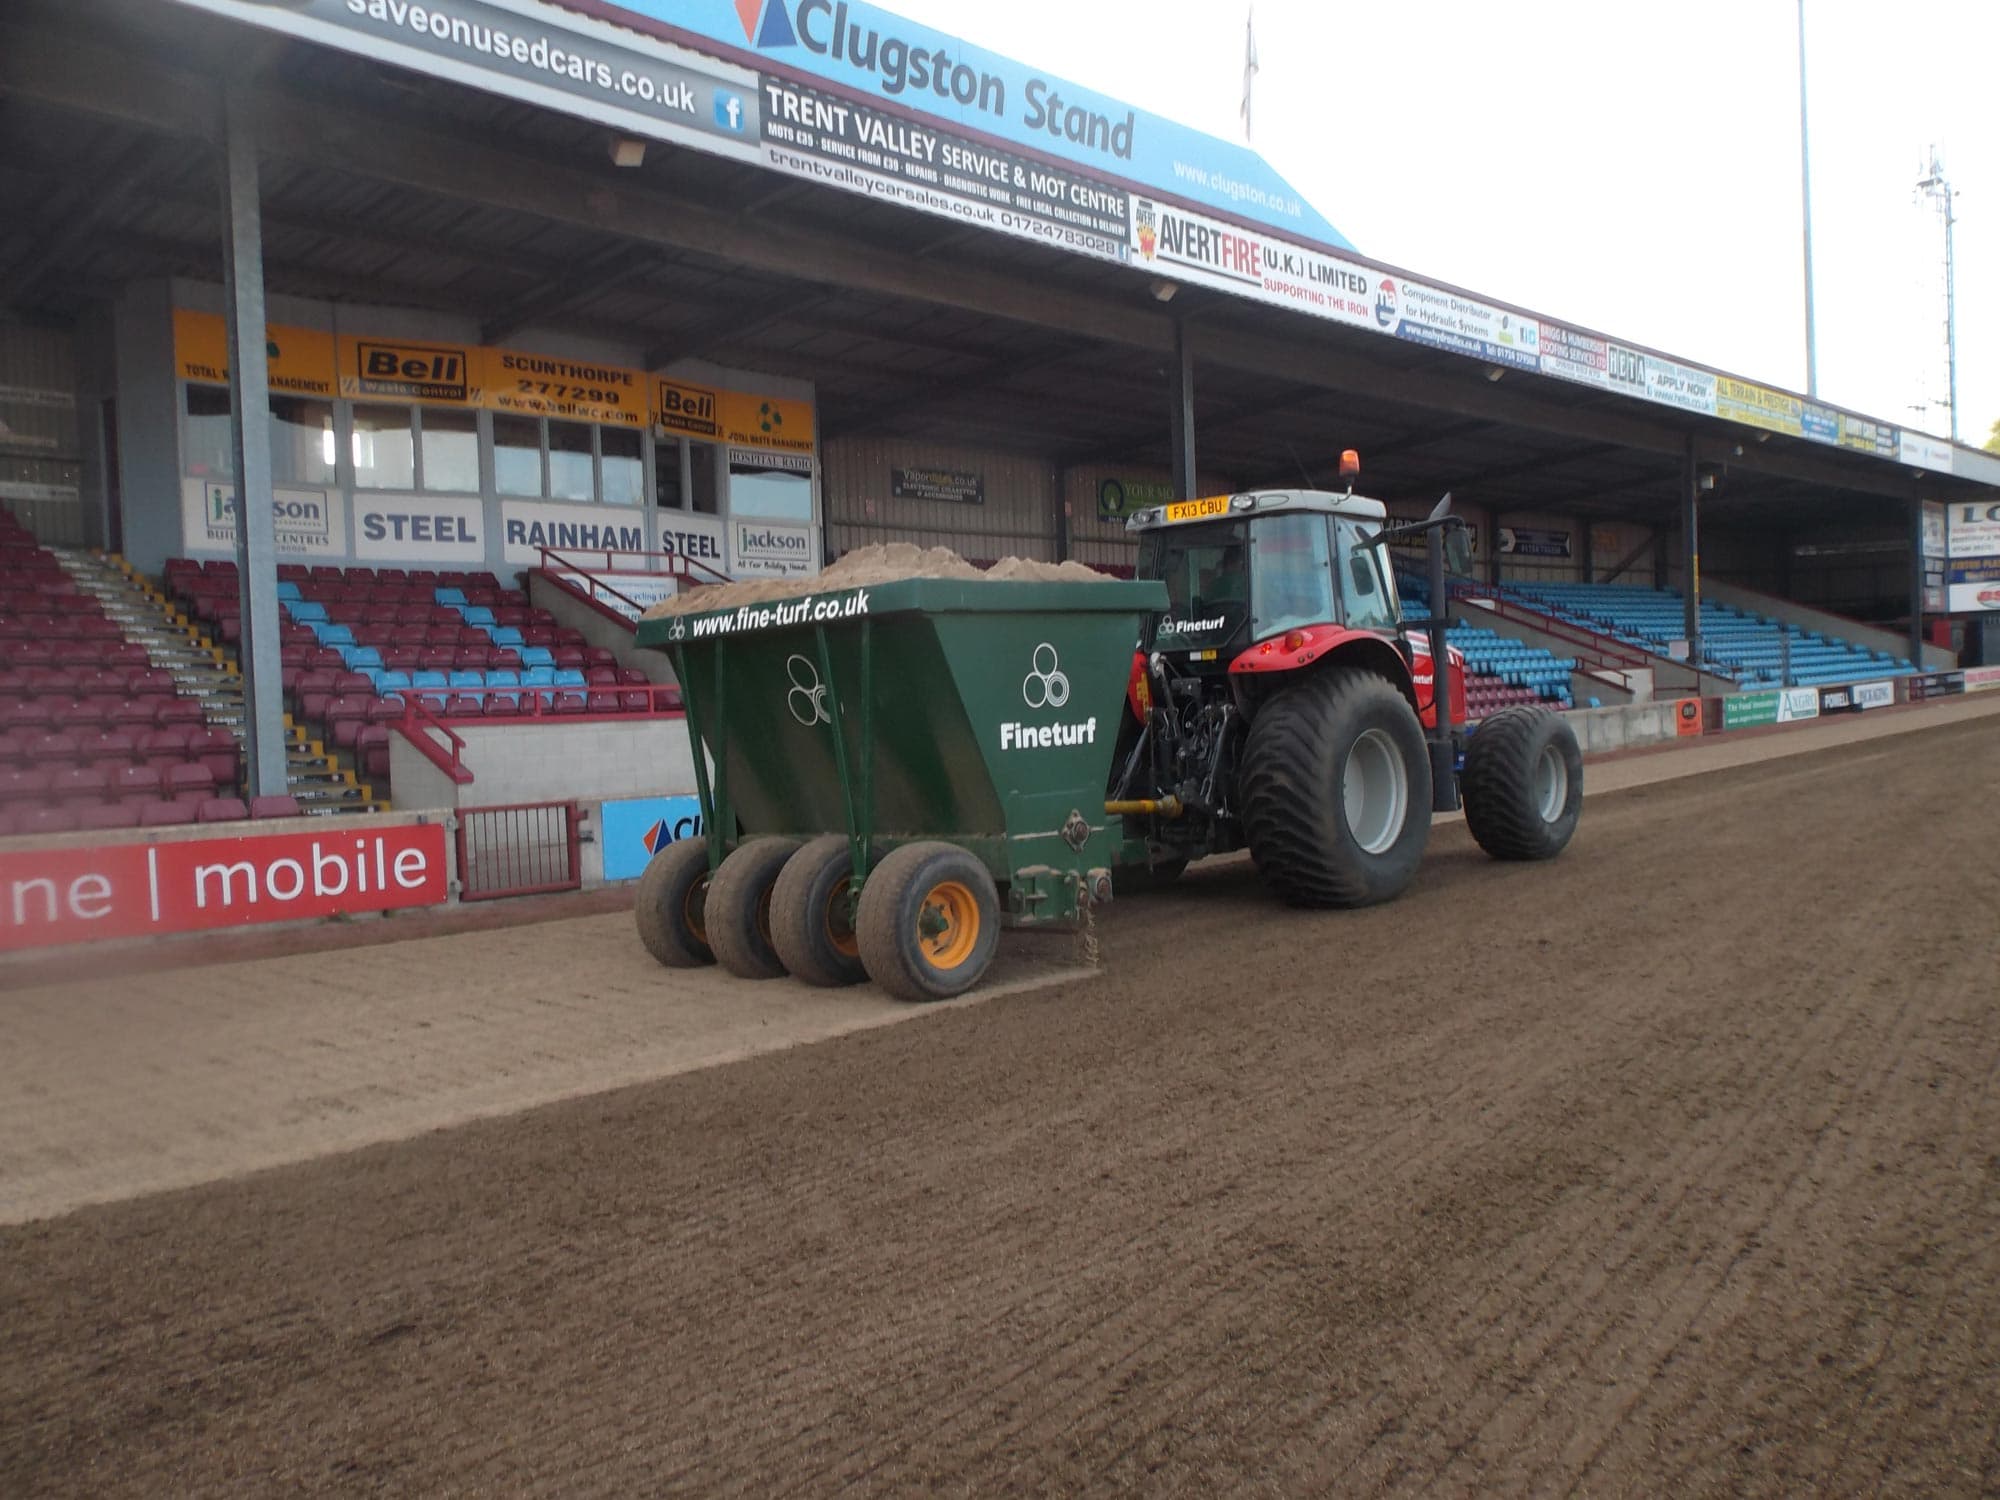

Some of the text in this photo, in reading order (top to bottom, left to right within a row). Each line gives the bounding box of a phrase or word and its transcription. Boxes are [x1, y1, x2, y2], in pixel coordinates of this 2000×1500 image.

[346, 0, 696, 114] saveonusedcars.co.uk
[797, 0, 1134, 160] Clugston Stand
[766, 85, 1125, 218] TRENT VALLEY SERVICE & MOT CENTRE
[768, 122, 794, 141] MOTS
[821, 137, 855, 160] SERVICE
[858, 148, 881, 166] FROM
[906, 162, 937, 183] REPAIRS
[944, 174, 987, 198] DIAGNOSTIC
[989, 187, 1011, 204] WORK
[1017, 194, 1031, 211] FREE
[1033, 199, 1052, 216] LOCAL
[1054, 206, 1091, 227] COLLECTION
[1099, 221, 1125, 237] DELIVERY
[770, 149, 994, 222] trentvalleycarsales.co.uk
[1173, 160, 1302, 217] www.clugston.co.uk
[1160, 215, 1367, 295] AVERTFIRE (U.K.) LIMITED
[1264, 277, 1369, 317] SUPPORTING THE IRON
[1402, 284, 1449, 306] Component
[1451, 298, 1490, 320] Distributor
[1406, 304, 1418, 316] for
[1420, 309, 1456, 327] Hydraulic
[1458, 319, 1488, 338] Systems
[367, 350, 458, 380] Bell
[503, 354, 633, 386] SCUNTHORPE
[270, 376, 330, 393] ANAGEMENT
[412, 386, 462, 398] Control
[517, 378, 620, 404] 277299
[1657, 374, 1708, 397] APPLY NOW
[498, 395, 638, 423] www.bellwc.com
[665, 389, 711, 418] Bell
[729, 450, 814, 470] HOSPITAL RADIO
[1174, 499, 1222, 519] FX13 CBU
[363, 512, 477, 543] STEEL
[507, 519, 642, 552] RAINHAM
[743, 527, 806, 552] jackson
[662, 530, 720, 559] STEEL
[692, 588, 869, 638] www.fine-turf.co.uk
[1177, 614, 1225, 633] Fineturf
[1001, 717, 1096, 750] Fineturf
[12, 836, 427, 925] ne mobile
